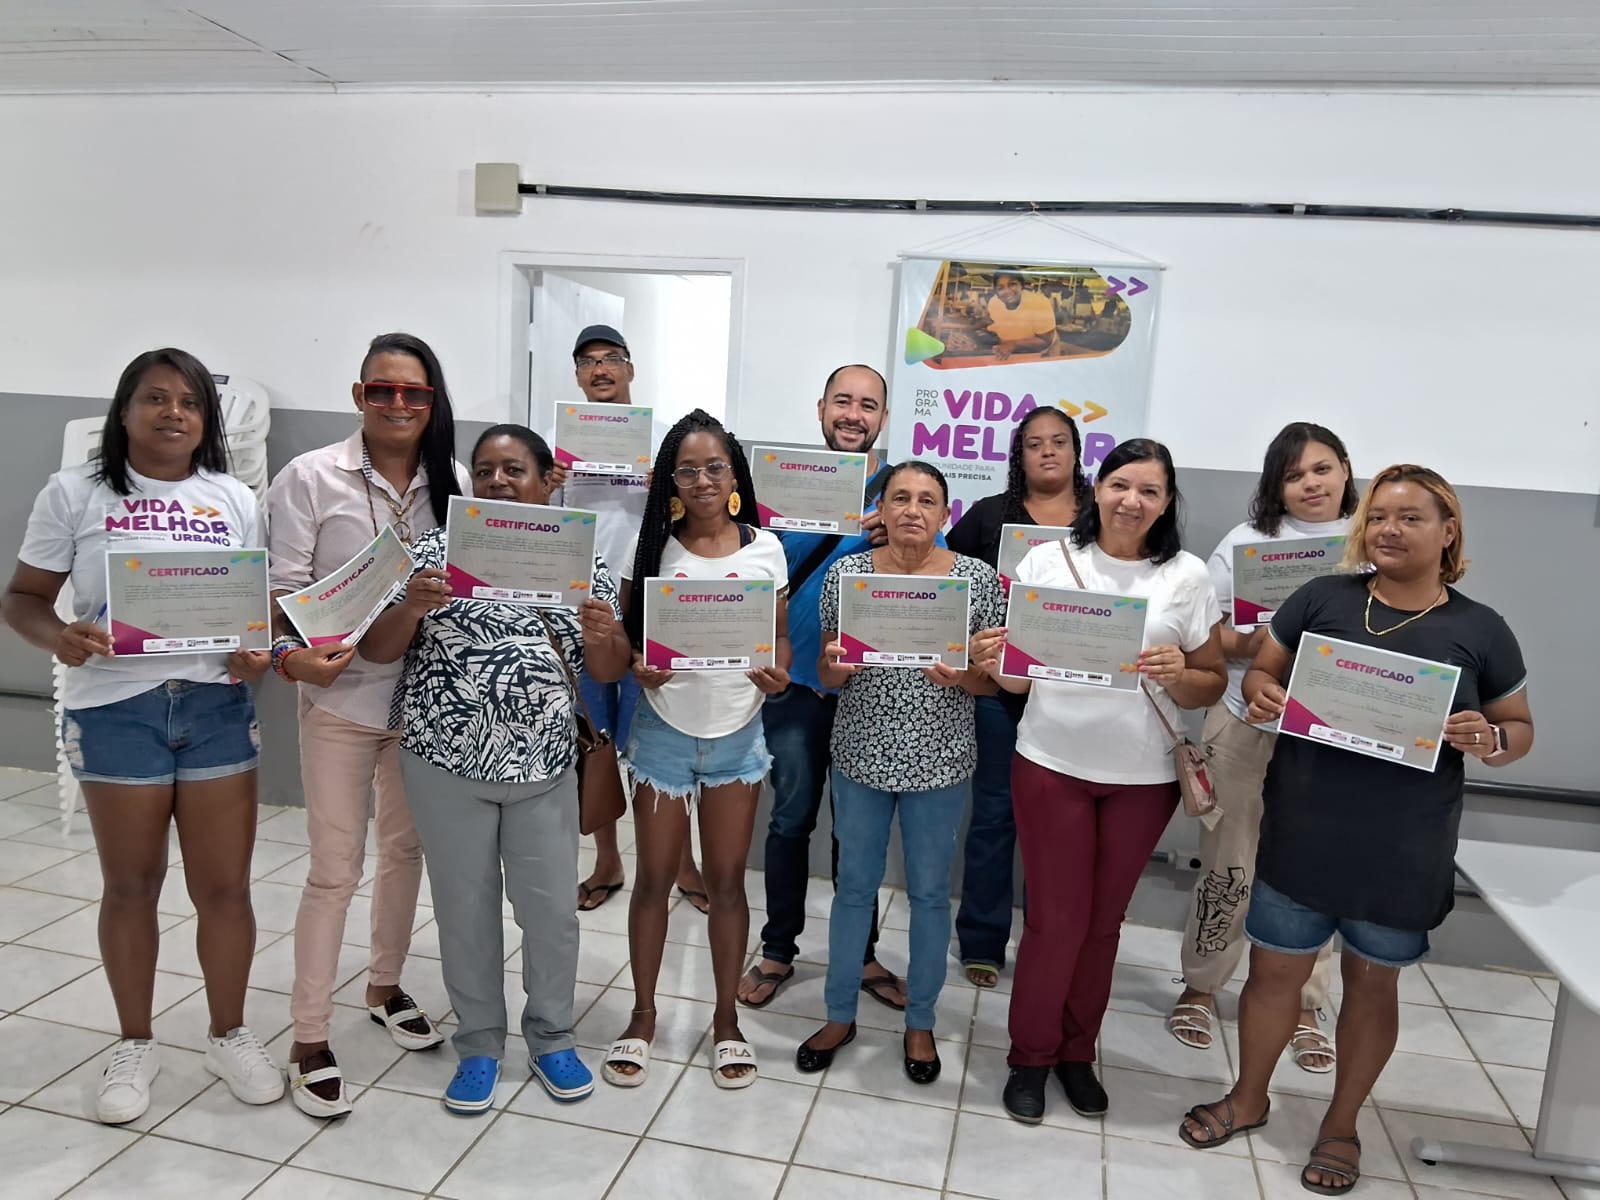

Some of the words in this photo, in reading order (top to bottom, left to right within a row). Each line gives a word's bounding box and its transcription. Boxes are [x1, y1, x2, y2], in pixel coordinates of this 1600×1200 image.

[915, 389, 939, 399] PRO
[915, 398, 939, 408] GRA
[943, 388, 1040, 423] VIDA
[914, 407, 932, 417] MA
[579, 414, 629, 424] CERTIFICADO
[912, 421, 1116, 468] MELR
[780, 462, 838, 474] CERTIFICADO
[957, 473, 992, 482] PRECISA
[122, 498, 186, 514] VIDA
[105, 514, 230, 536] MELHOR
[485, 518, 561, 533] CERTIFICADO
[172, 533, 231, 547] URBANO
[1261, 549, 1326, 562] CERTIFICADO
[148, 566, 230, 577] CERTIFICADO
[318, 556, 375, 602] CERTIFICADO
[678, 594, 744, 602] CERTIFICADO
[872, 590, 937, 600] CERTIFICADO
[1042, 601, 1113, 617] CERTIFICADO
[1336, 658, 1415, 685] CERTIFICADO
[611, 1045, 644, 1059] FILA
[718, 1047, 752, 1060] FILA
